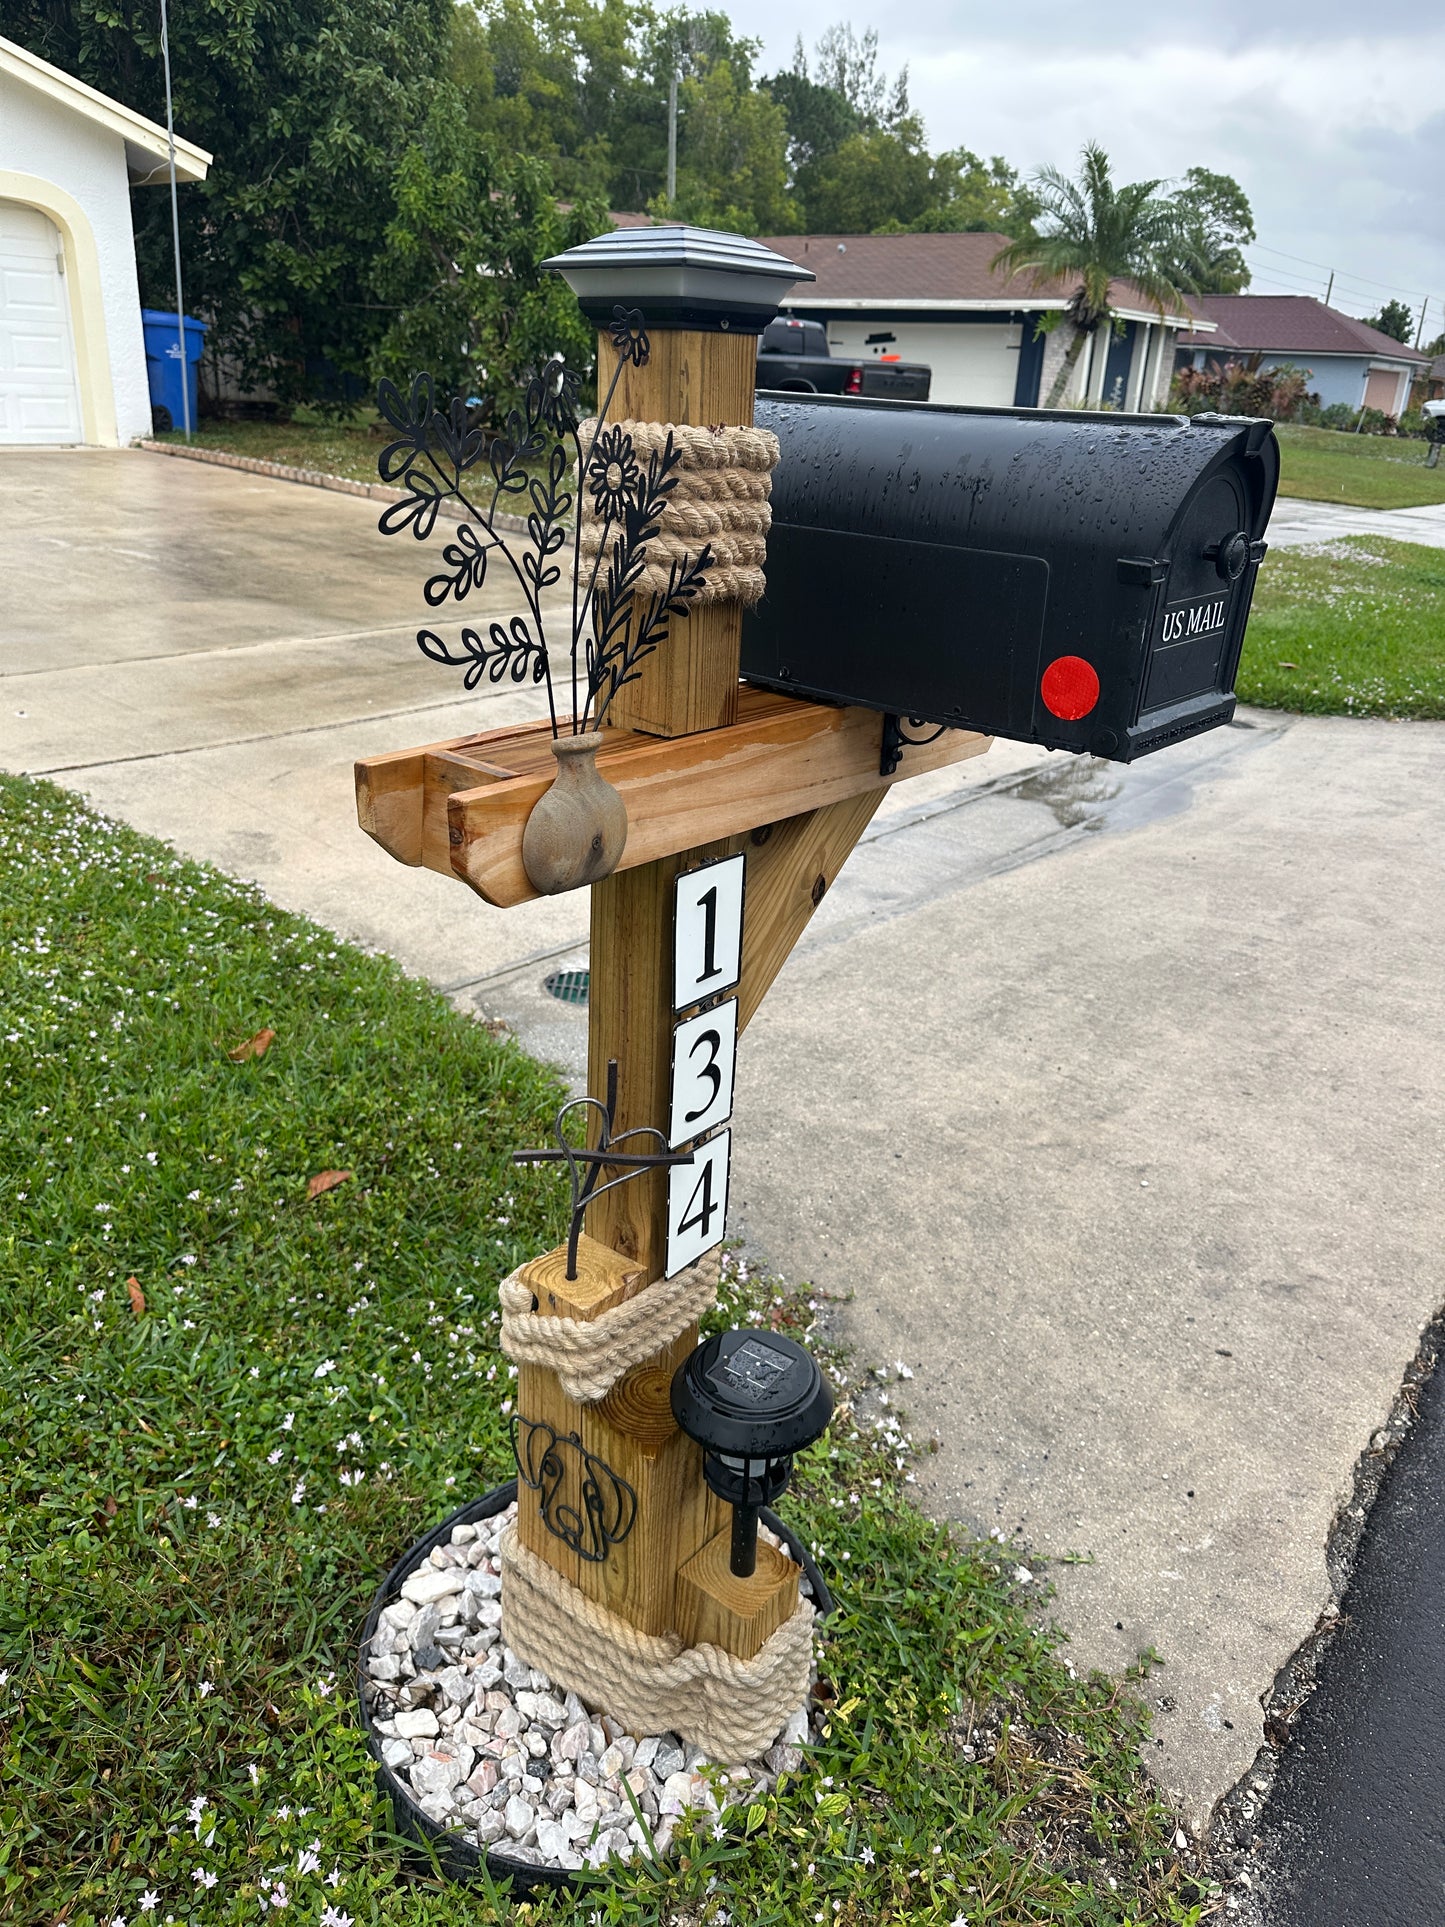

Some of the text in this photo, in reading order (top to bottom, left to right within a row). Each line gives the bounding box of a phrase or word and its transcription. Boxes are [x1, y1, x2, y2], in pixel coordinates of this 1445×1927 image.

[1162, 601, 1225, 642] US MAIL
[696, 886, 722, 983] 1
[685, 1029, 721, 1122] 3
[677, 1159, 718, 1238] 4
